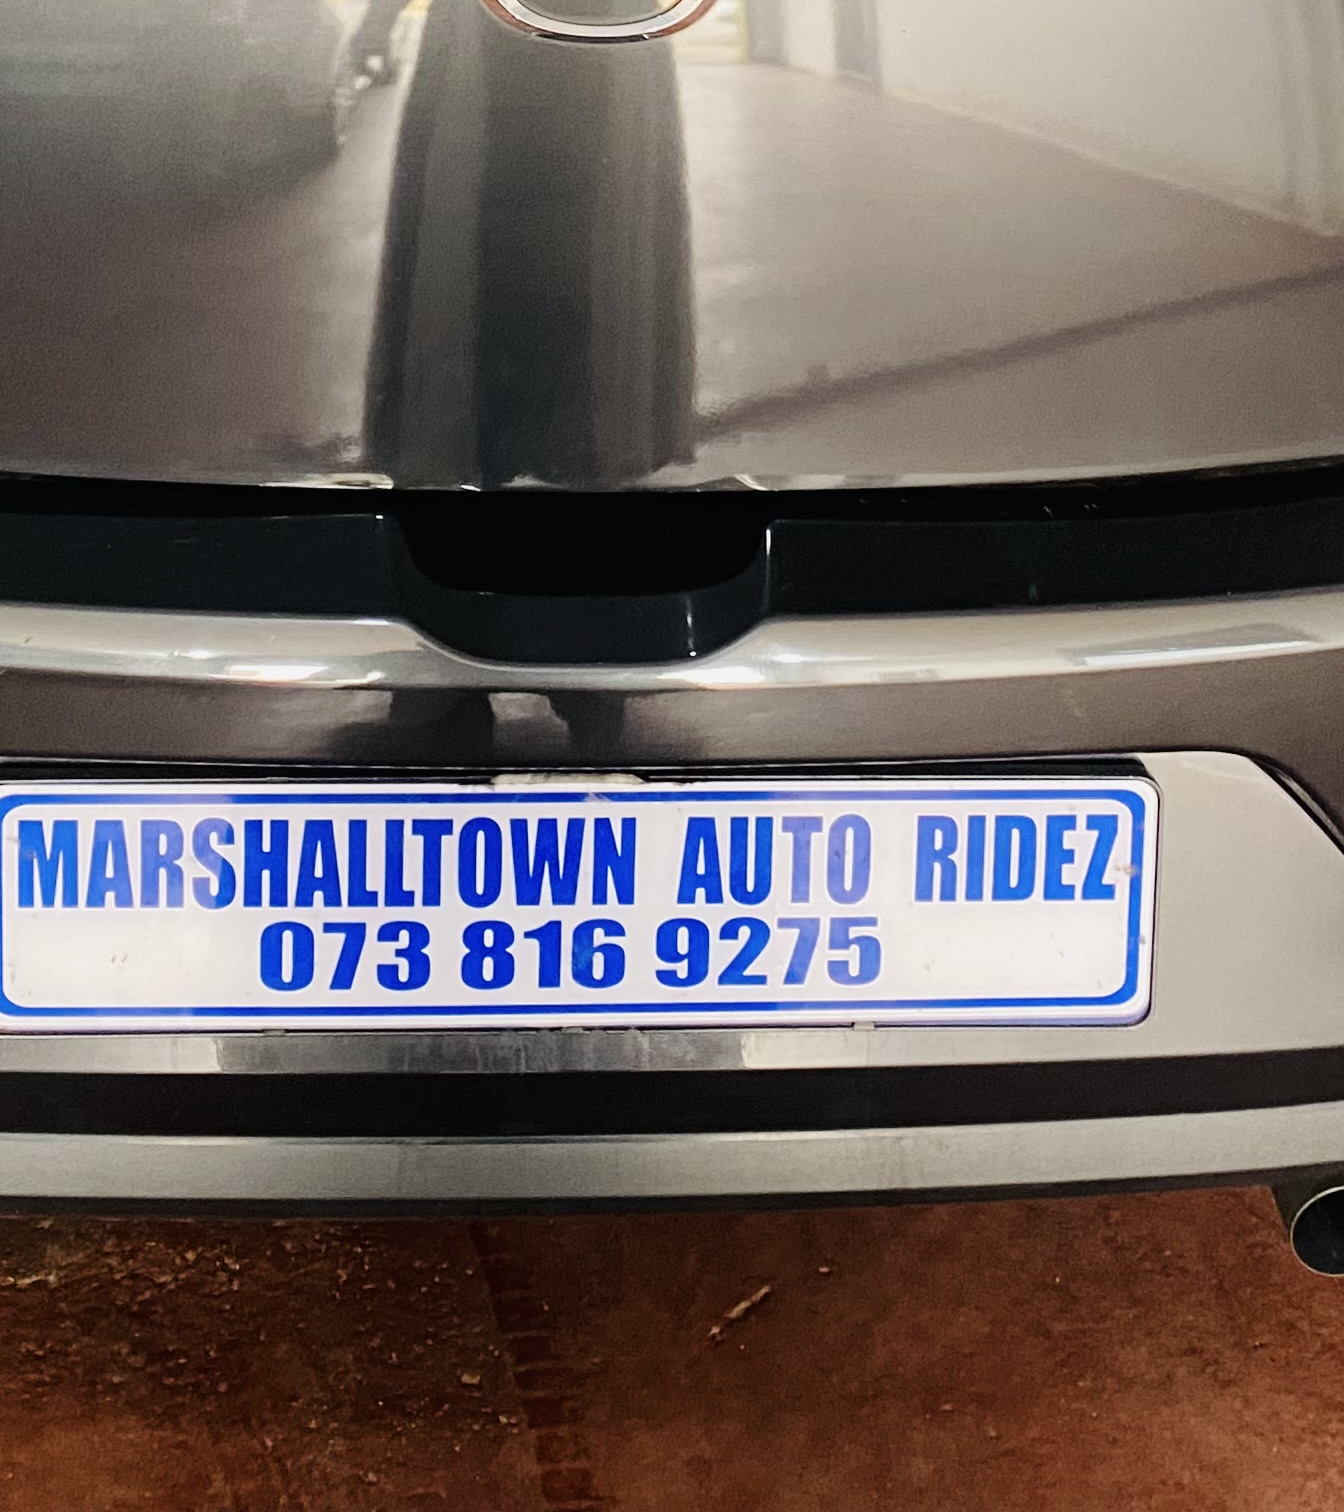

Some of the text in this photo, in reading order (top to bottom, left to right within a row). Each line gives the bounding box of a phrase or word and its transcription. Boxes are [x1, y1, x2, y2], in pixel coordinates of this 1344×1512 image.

[17, 814, 1119, 909] MARSHALLTOWN AUTO RIDEZ
[259, 916, 881, 992] 073 816 9275
